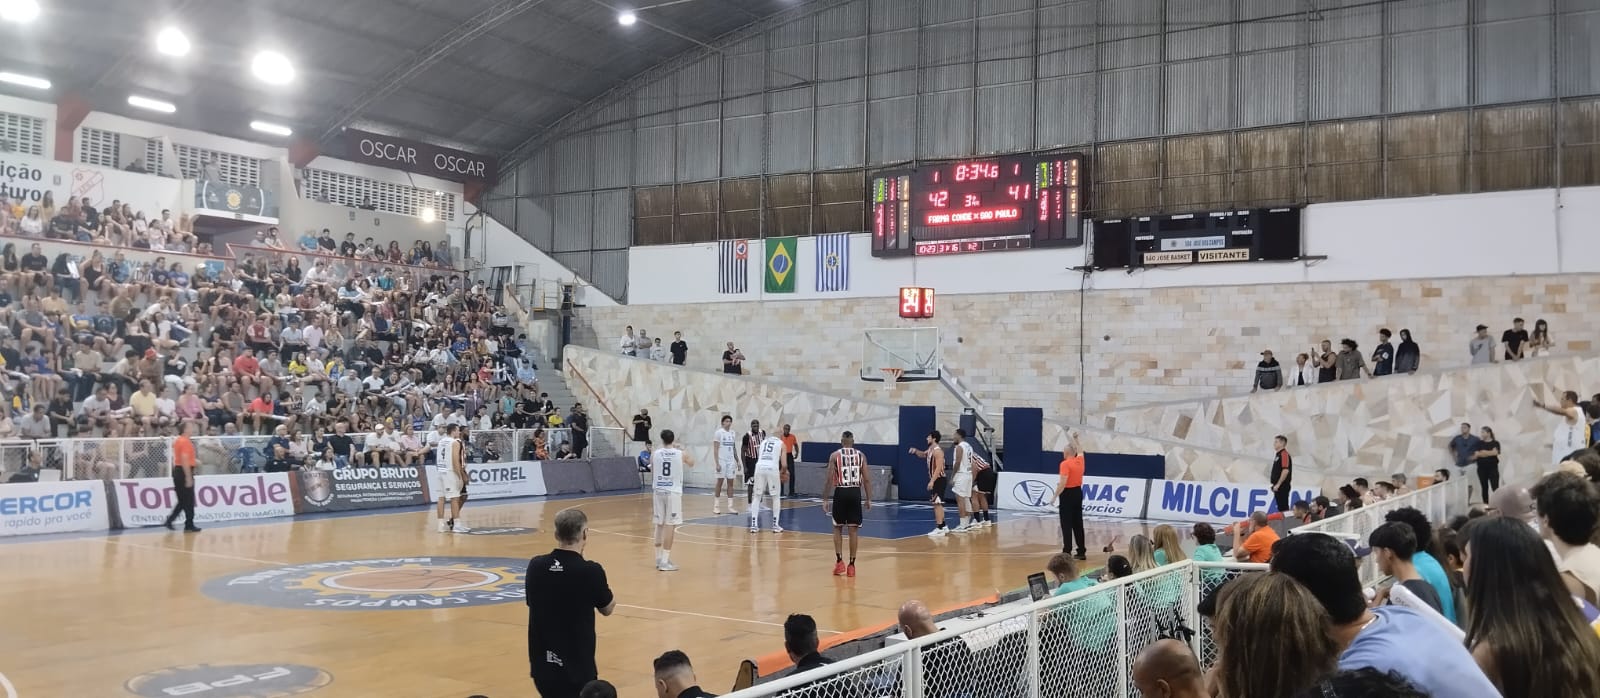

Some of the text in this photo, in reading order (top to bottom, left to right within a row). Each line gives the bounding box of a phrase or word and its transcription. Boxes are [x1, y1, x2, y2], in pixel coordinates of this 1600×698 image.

[360, 139, 416, 164] OSCAR
[434, 153, 485, 177] OSCAR
[955, 164, 998, 181] 8:34.6
[928, 190, 949, 207] 42
[1008, 183, 1031, 200] 41
[928, 214, 949, 223] FARMA
[951, 212, 972, 222] CONDE
[995, 209, 1018, 219] PAULO
[1170, 253, 1191, 261] BASKET
[1199, 251, 1247, 260] VISITANTE
[440, 447, 446, 460] 4
[763, 442, 775, 453] 15
[333, 466, 378, 480] GRUPO
[380, 465, 418, 479] BRUTO
[662, 461, 671, 477] 8
[335, 483, 381, 492] SEGURANÇA
[388, 480, 421, 489] SERVIÇOS
[304, 596, 469, 607] CAMPOS
